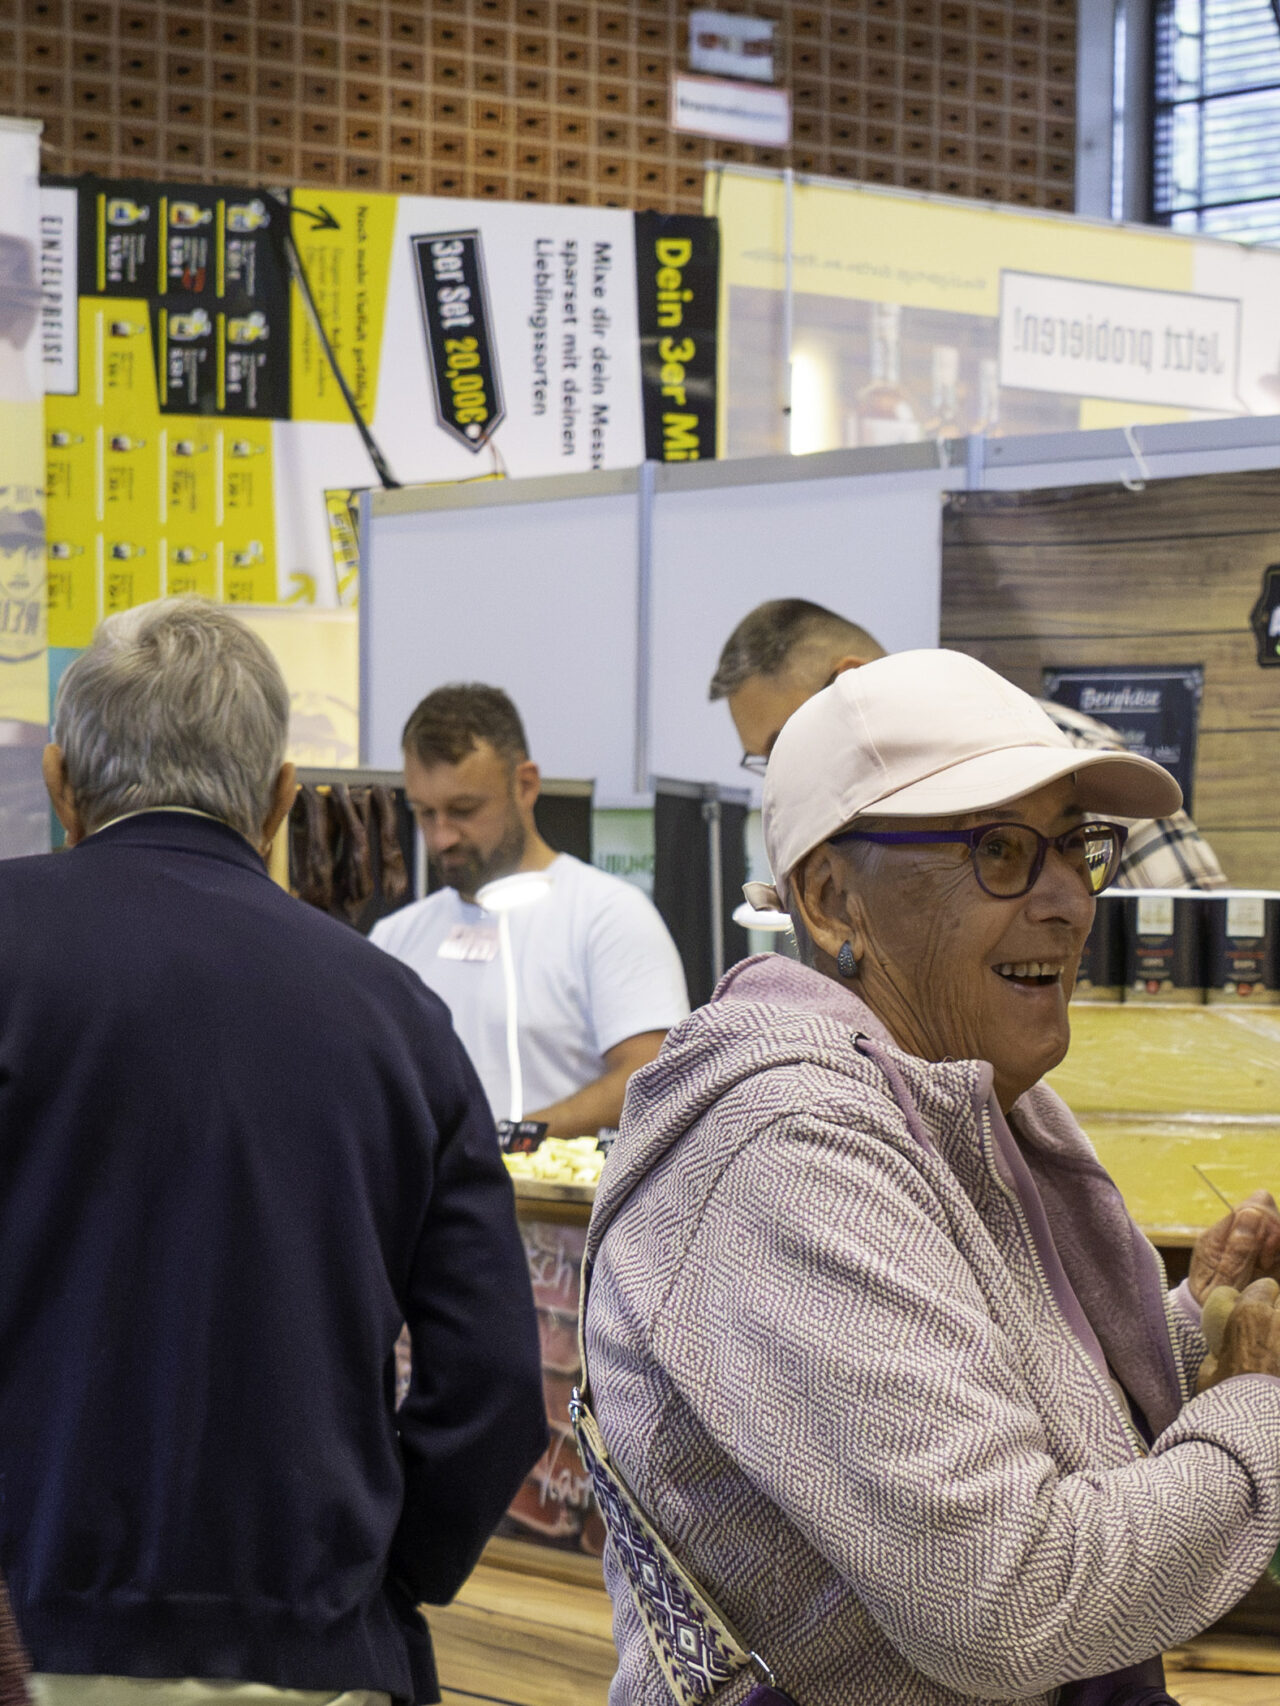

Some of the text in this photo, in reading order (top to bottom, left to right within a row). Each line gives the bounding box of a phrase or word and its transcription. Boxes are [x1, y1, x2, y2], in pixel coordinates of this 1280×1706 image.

[41, 216, 64, 364] EINZELPREISE
[592, 241, 611, 299] Mixe
[655, 237, 693, 327] Dein
[430, 240, 488, 424] 3er Set 20,00€
[528, 238, 554, 417] Lieblingssorten
[561, 334, 581, 371] mit
[592, 307, 610, 338] dir
[592, 346, 610, 396] dein
[658, 336, 696, 406] 3er
[560, 378, 581, 456] deinen
